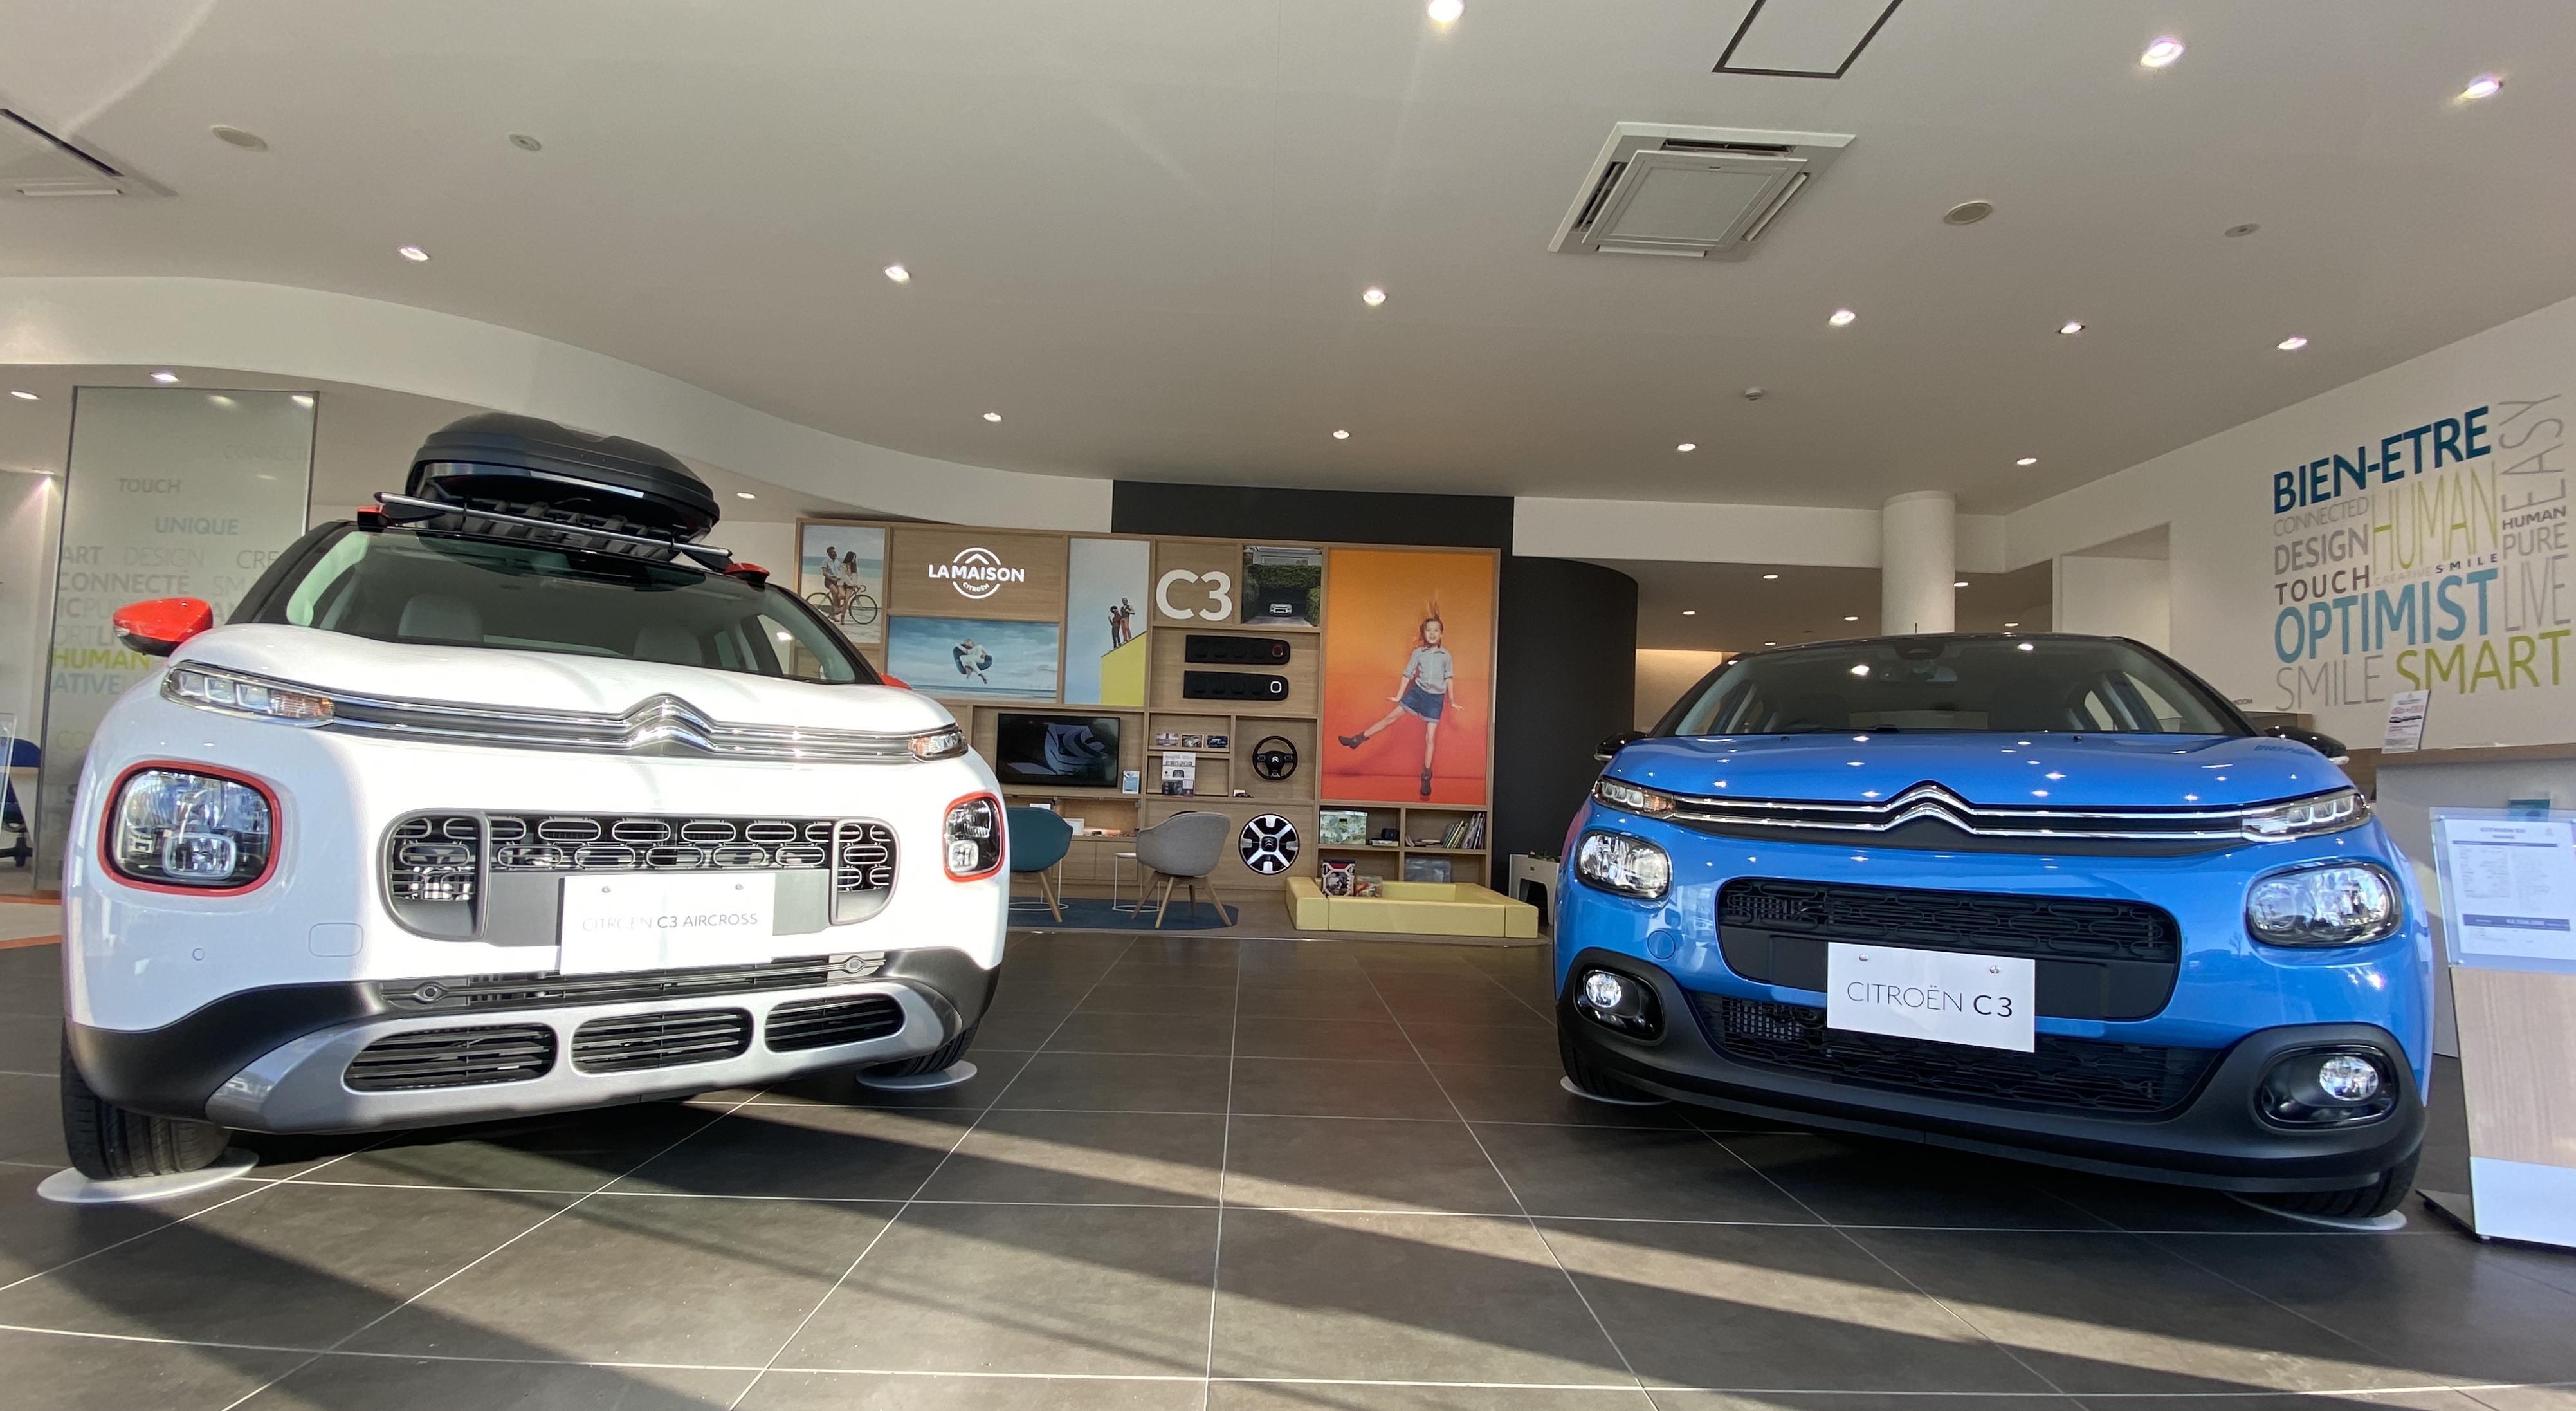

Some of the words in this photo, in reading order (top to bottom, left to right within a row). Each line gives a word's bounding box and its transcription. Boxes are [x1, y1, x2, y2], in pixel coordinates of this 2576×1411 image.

[2274, 405, 2492, 515] BIEN-ETRE
[2498, 393, 2566, 513] EASY
[118, 477, 182, 494] TOUCH
[154, 517, 239, 535] UNIQUE
[2274, 496, 2369, 537] CONNECTED
[2371, 460, 2498, 576] HUMAN
[2503, 506, 2567, 530] HUMAN
[124, 547, 205, 567] DESIGN
[2274, 523, 2369, 575] DESIGN
[2503, 522, 2568, 560] PURE
[2436, 553, 2498, 574] SMILE
[212, 575, 257, 597] SM
[1156, 569, 1233, 622] C3
[2274, 565, 2370, 605] TOUCH
[2503, 553, 2571, 632] LIVE
[2274, 567, 2499, 664] OPTIMIST
[53, 647, 151, 671] HUMAN
[2395, 629, 2571, 695] SMART
[2276, 654, 2386, 712] SMILE
[657, 916, 679, 929] C3
[683, 912, 759, 928] AIRCROSS
[1847, 981, 1963, 1013] CITROËN
